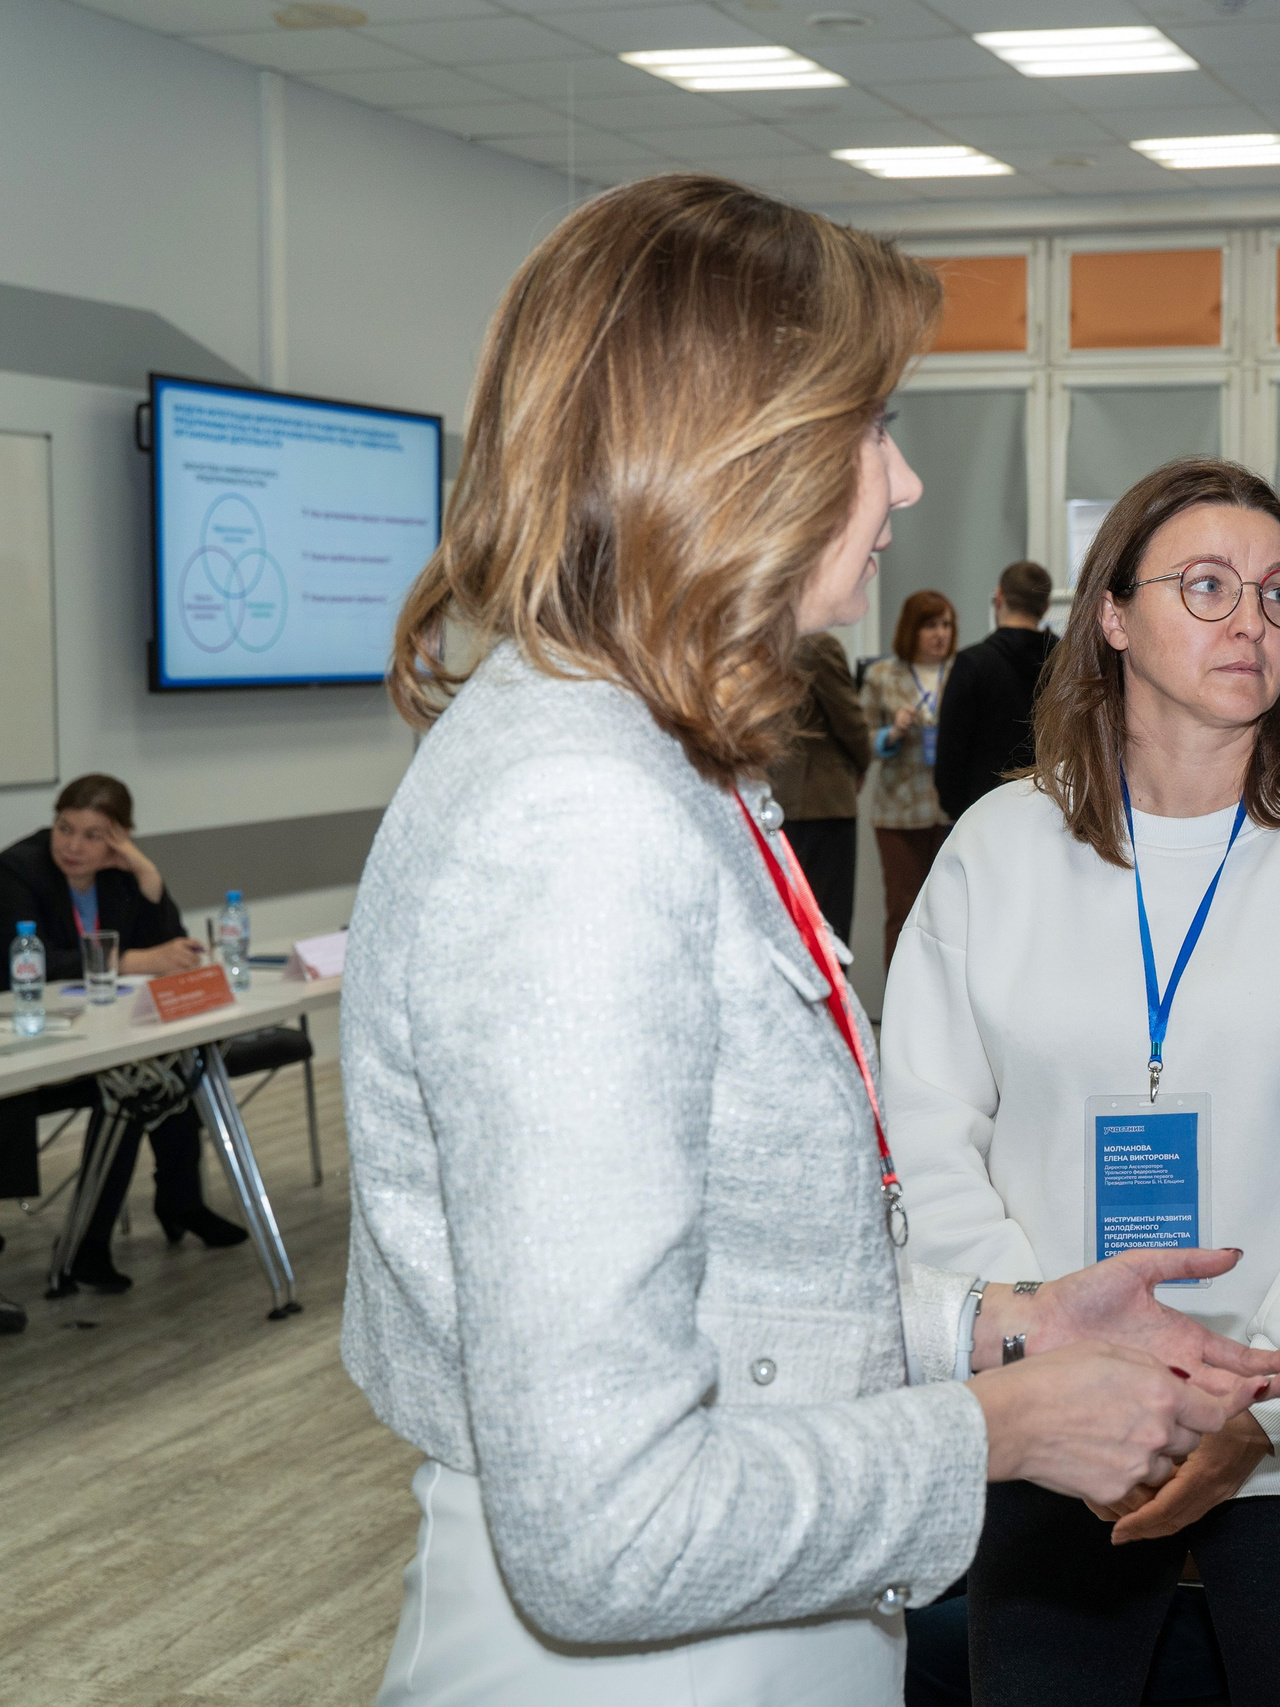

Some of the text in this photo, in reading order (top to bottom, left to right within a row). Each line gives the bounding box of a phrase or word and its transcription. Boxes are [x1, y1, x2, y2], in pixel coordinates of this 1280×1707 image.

[1104, 1125, 1145, 1135] участник
[1104, 1232, 1191, 1240] ПРЕДПРИНИМАТЕЛЬСТВА
[1111, 1240, 1178, 1248] ОБРАЗОВАТЕЛЬНОЙ
